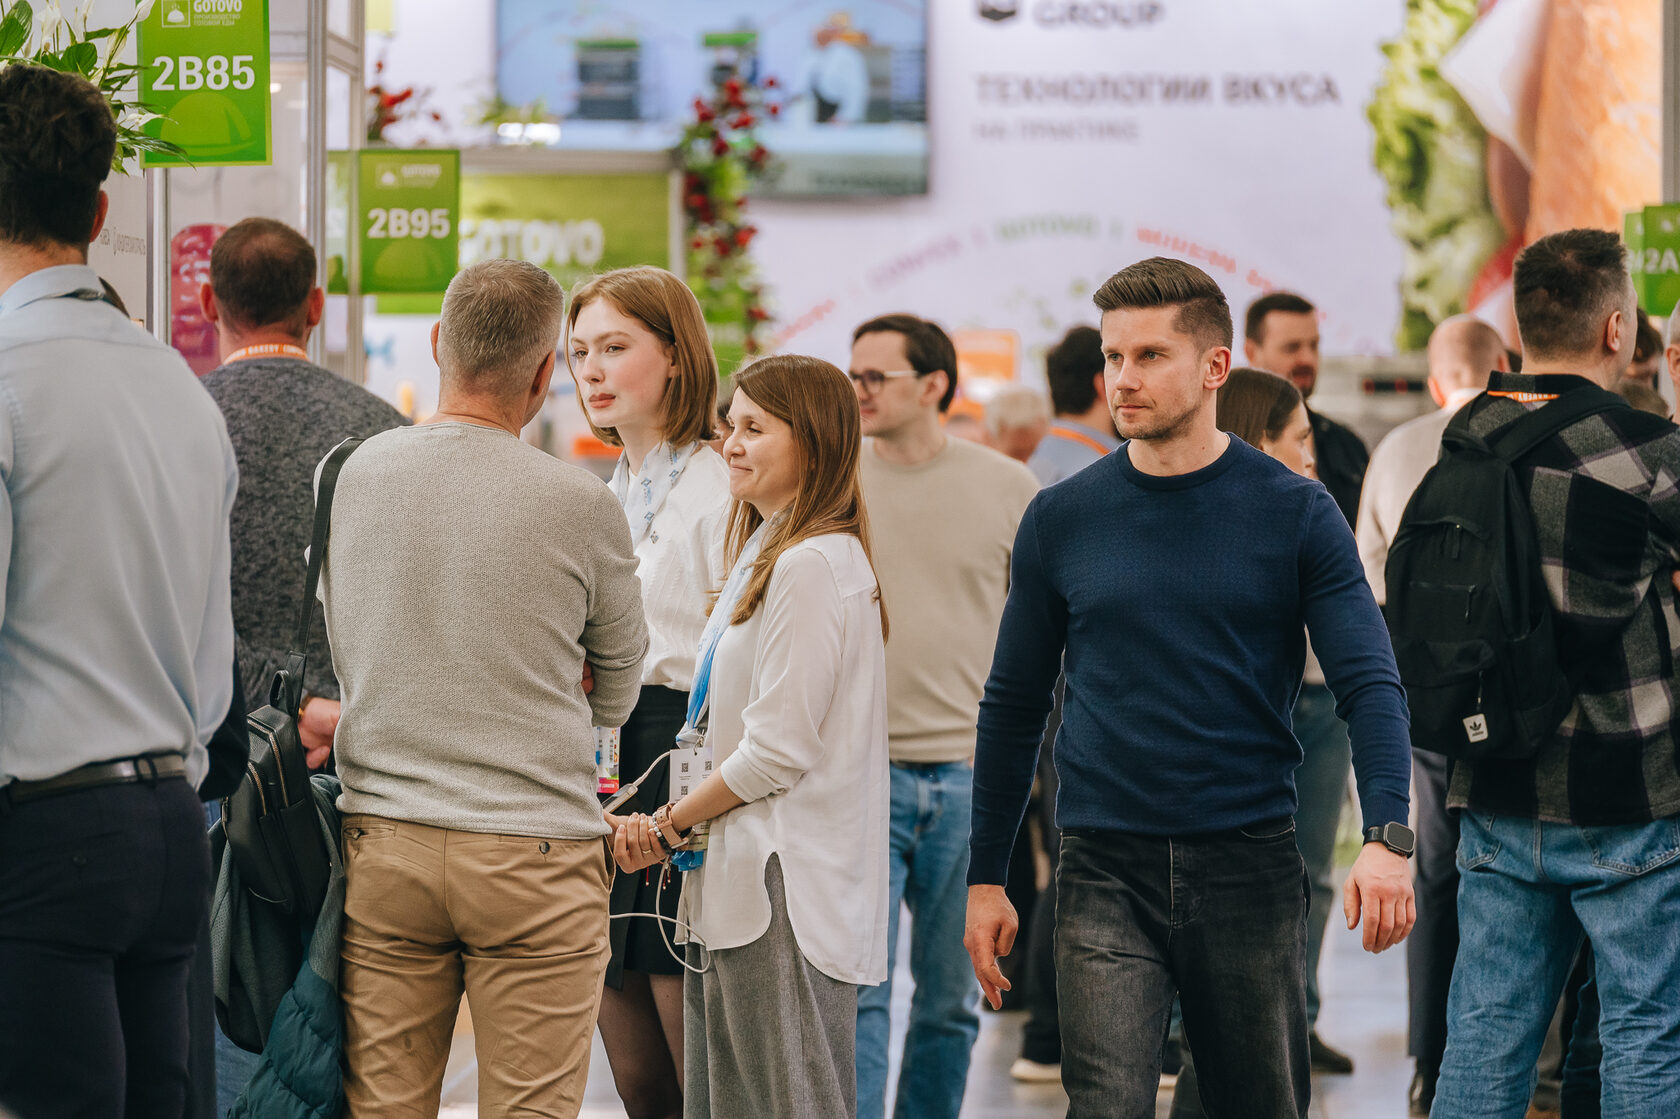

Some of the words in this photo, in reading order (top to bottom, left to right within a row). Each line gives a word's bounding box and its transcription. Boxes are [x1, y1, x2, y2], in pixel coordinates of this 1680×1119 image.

[193, 0, 242, 13] GOTOVO
[152, 55, 255, 91] 2B85
[976, 74, 1212, 103] ТЕХНОЛОГИИ
[1224, 74, 1341, 103] ВКУСА
[367, 207, 450, 239] 2B95
[458, 219, 604, 264] GOTOVO
[1645, 248, 1680, 274] 2A
